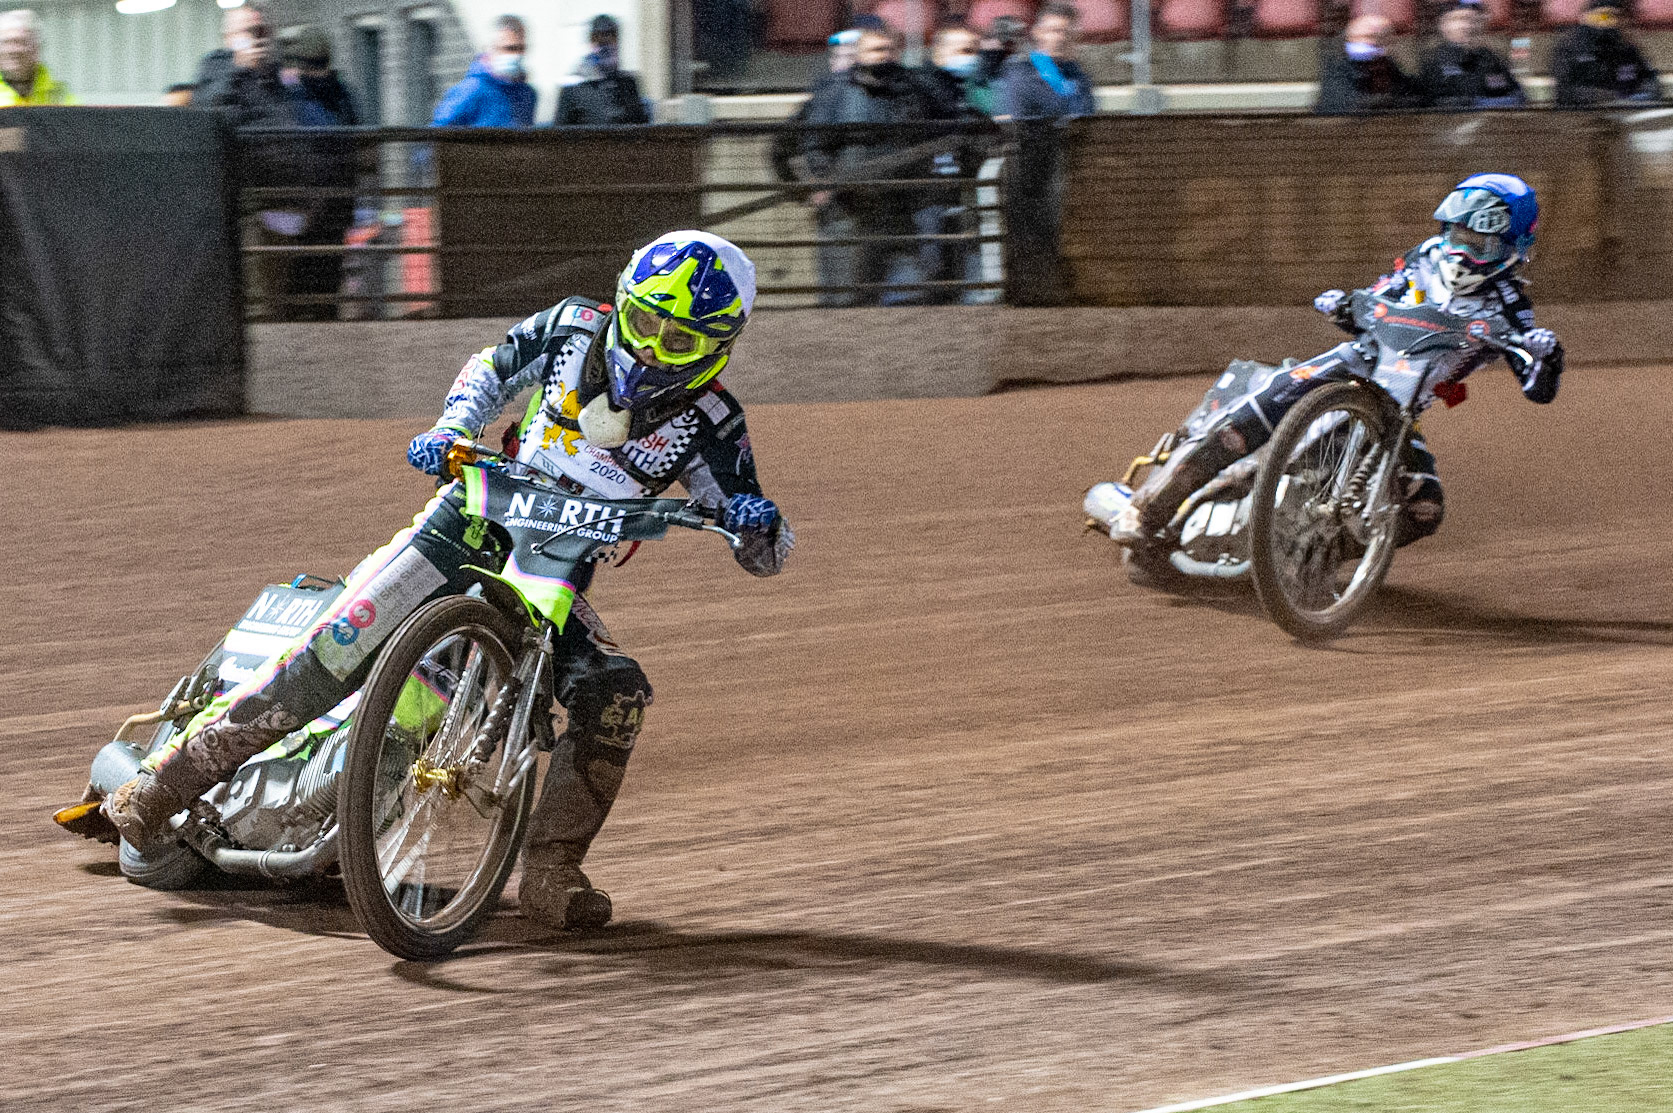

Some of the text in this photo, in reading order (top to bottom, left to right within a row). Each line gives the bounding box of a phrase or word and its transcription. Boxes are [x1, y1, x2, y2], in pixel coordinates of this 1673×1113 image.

[589, 461, 627, 485] 2020
[504, 517, 618, 543] ENGINEERING GROUP
